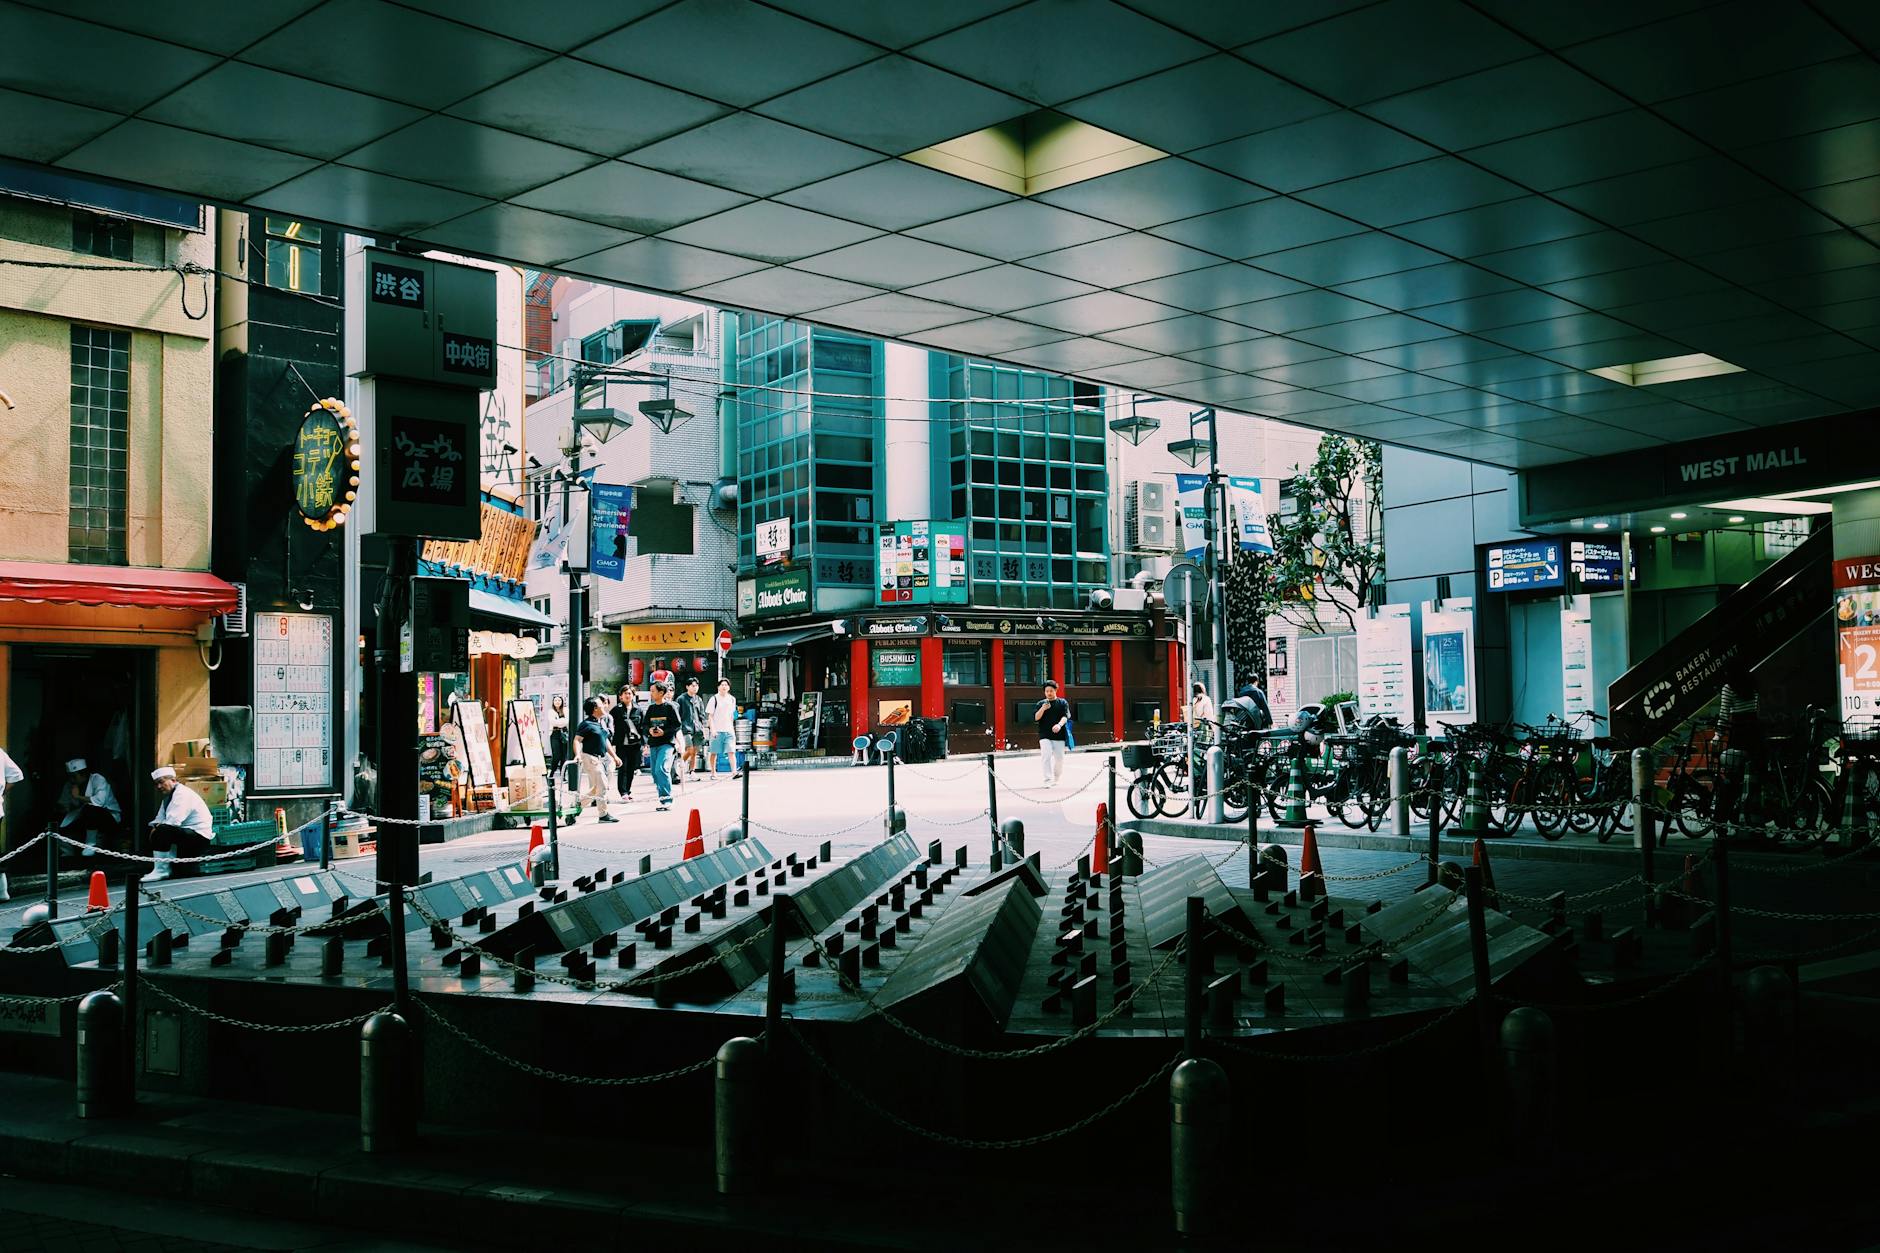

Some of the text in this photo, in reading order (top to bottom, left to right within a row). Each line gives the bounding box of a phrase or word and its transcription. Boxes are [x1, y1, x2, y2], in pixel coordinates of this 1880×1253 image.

[375, 271, 422, 302] 渋谷
[445, 340, 490, 370] 中央街
[1681, 447, 1807, 482] WEST MALL
[402, 460, 455, 492] 広場
[296, 473, 334, 508] 小鉄
[593, 508, 627, 517] Immersive
[596, 559, 619, 567] GMO
[758, 587, 807, 609] Abbot's Choice
[661, 630, 706, 644] いこい
[869, 623, 918, 634] Abbot's Choice
[1102, 623, 1129, 633] JAMESON
[874, 639, 918, 647] PUBLIC HOUSE
[879, 654, 917, 664] BUSHMILLS
[1675, 648, 1712, 682] BAKERY
[1680, 644, 1740, 696] RESTAURANT
